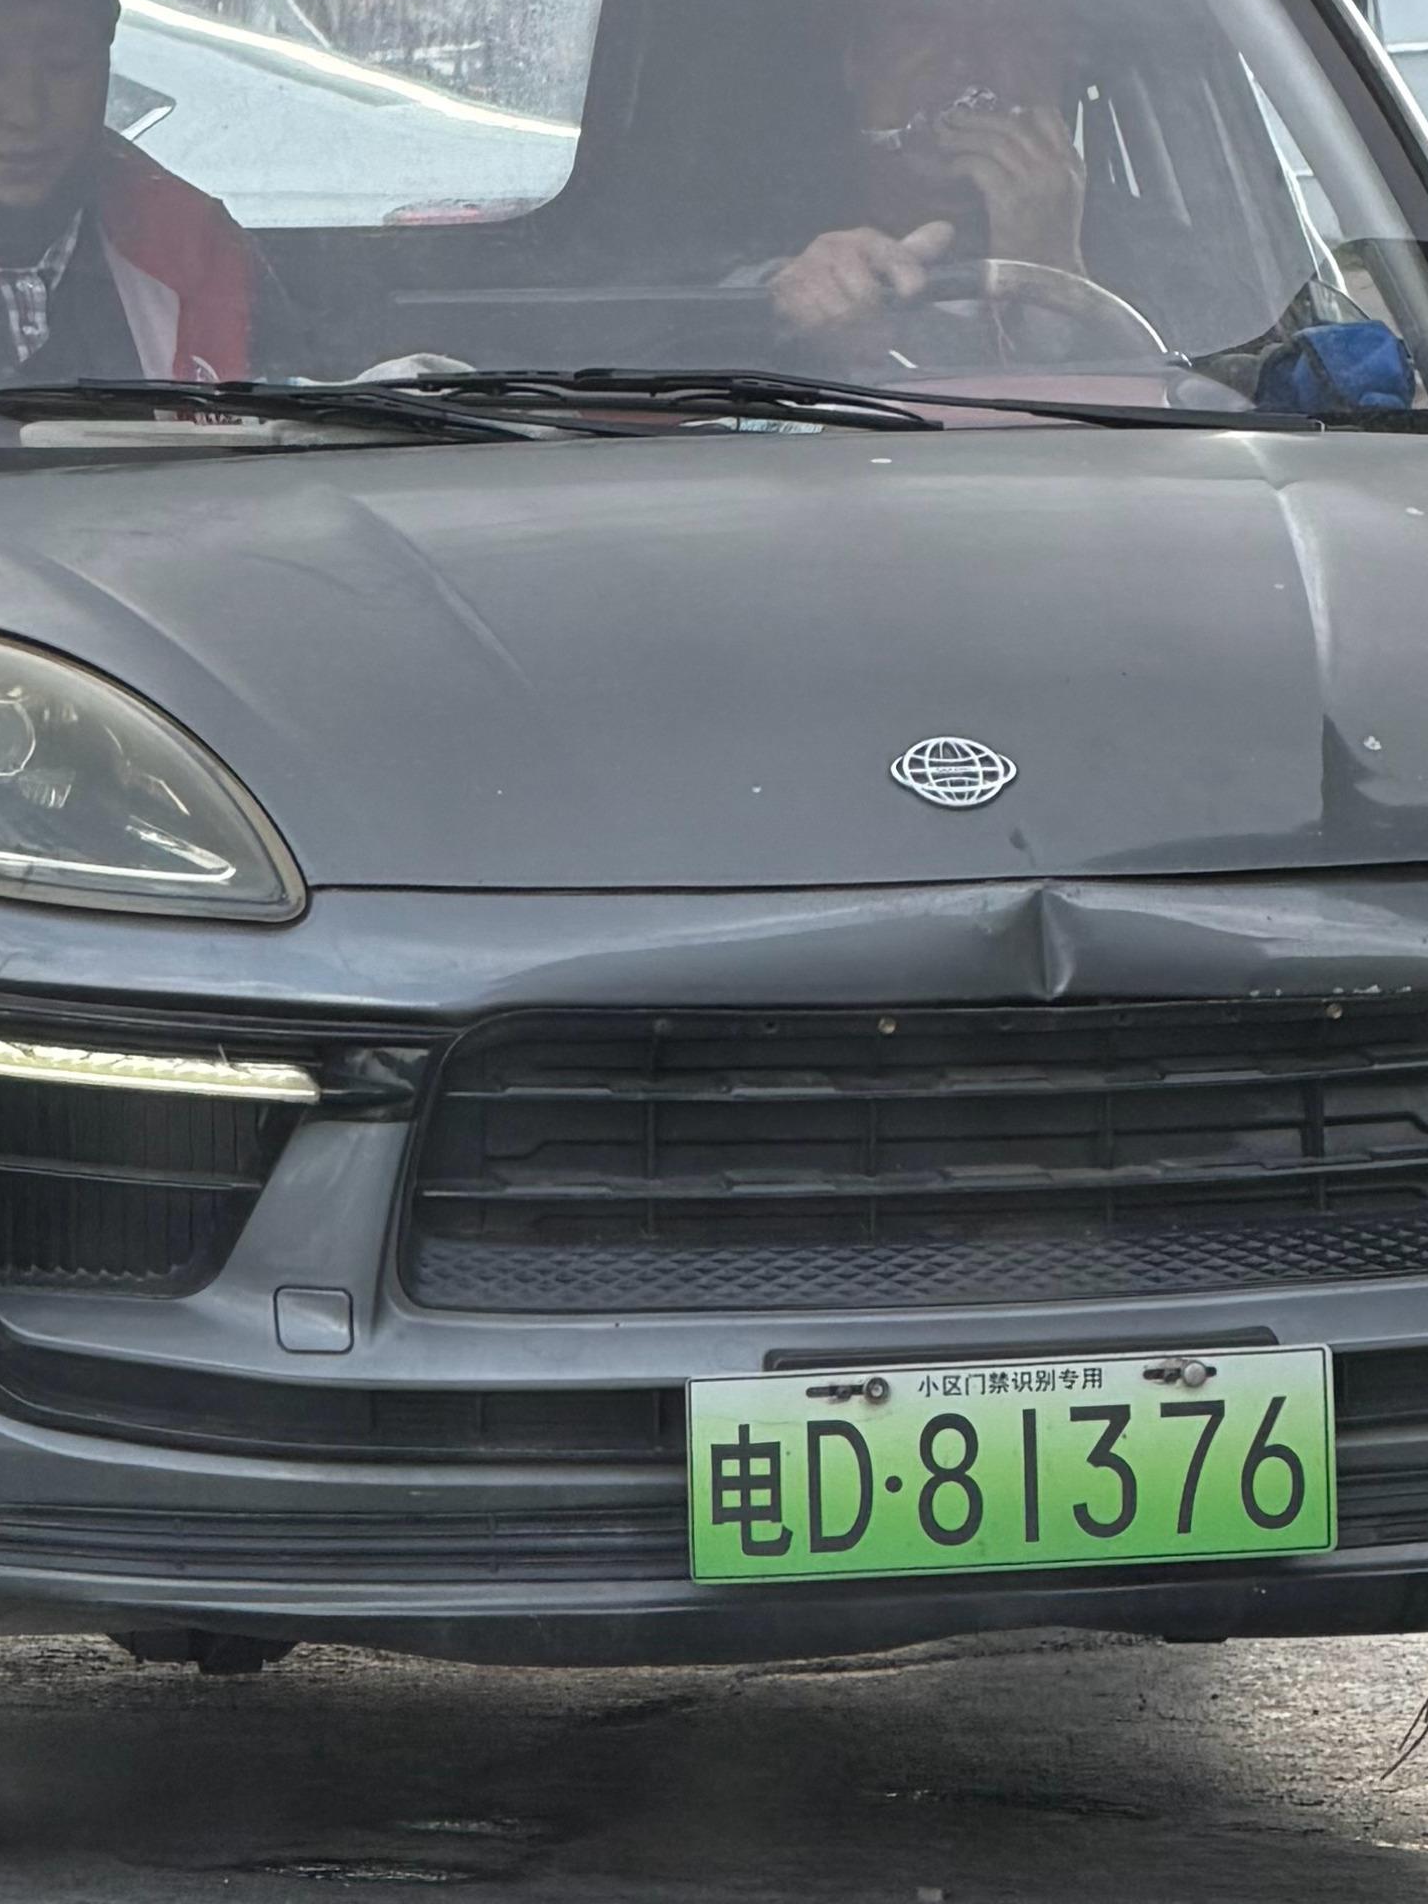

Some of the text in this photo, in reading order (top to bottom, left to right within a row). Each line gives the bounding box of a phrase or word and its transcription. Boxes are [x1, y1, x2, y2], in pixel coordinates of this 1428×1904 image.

[917, 1366, 1103, 1398] 小区门禁识别专用
